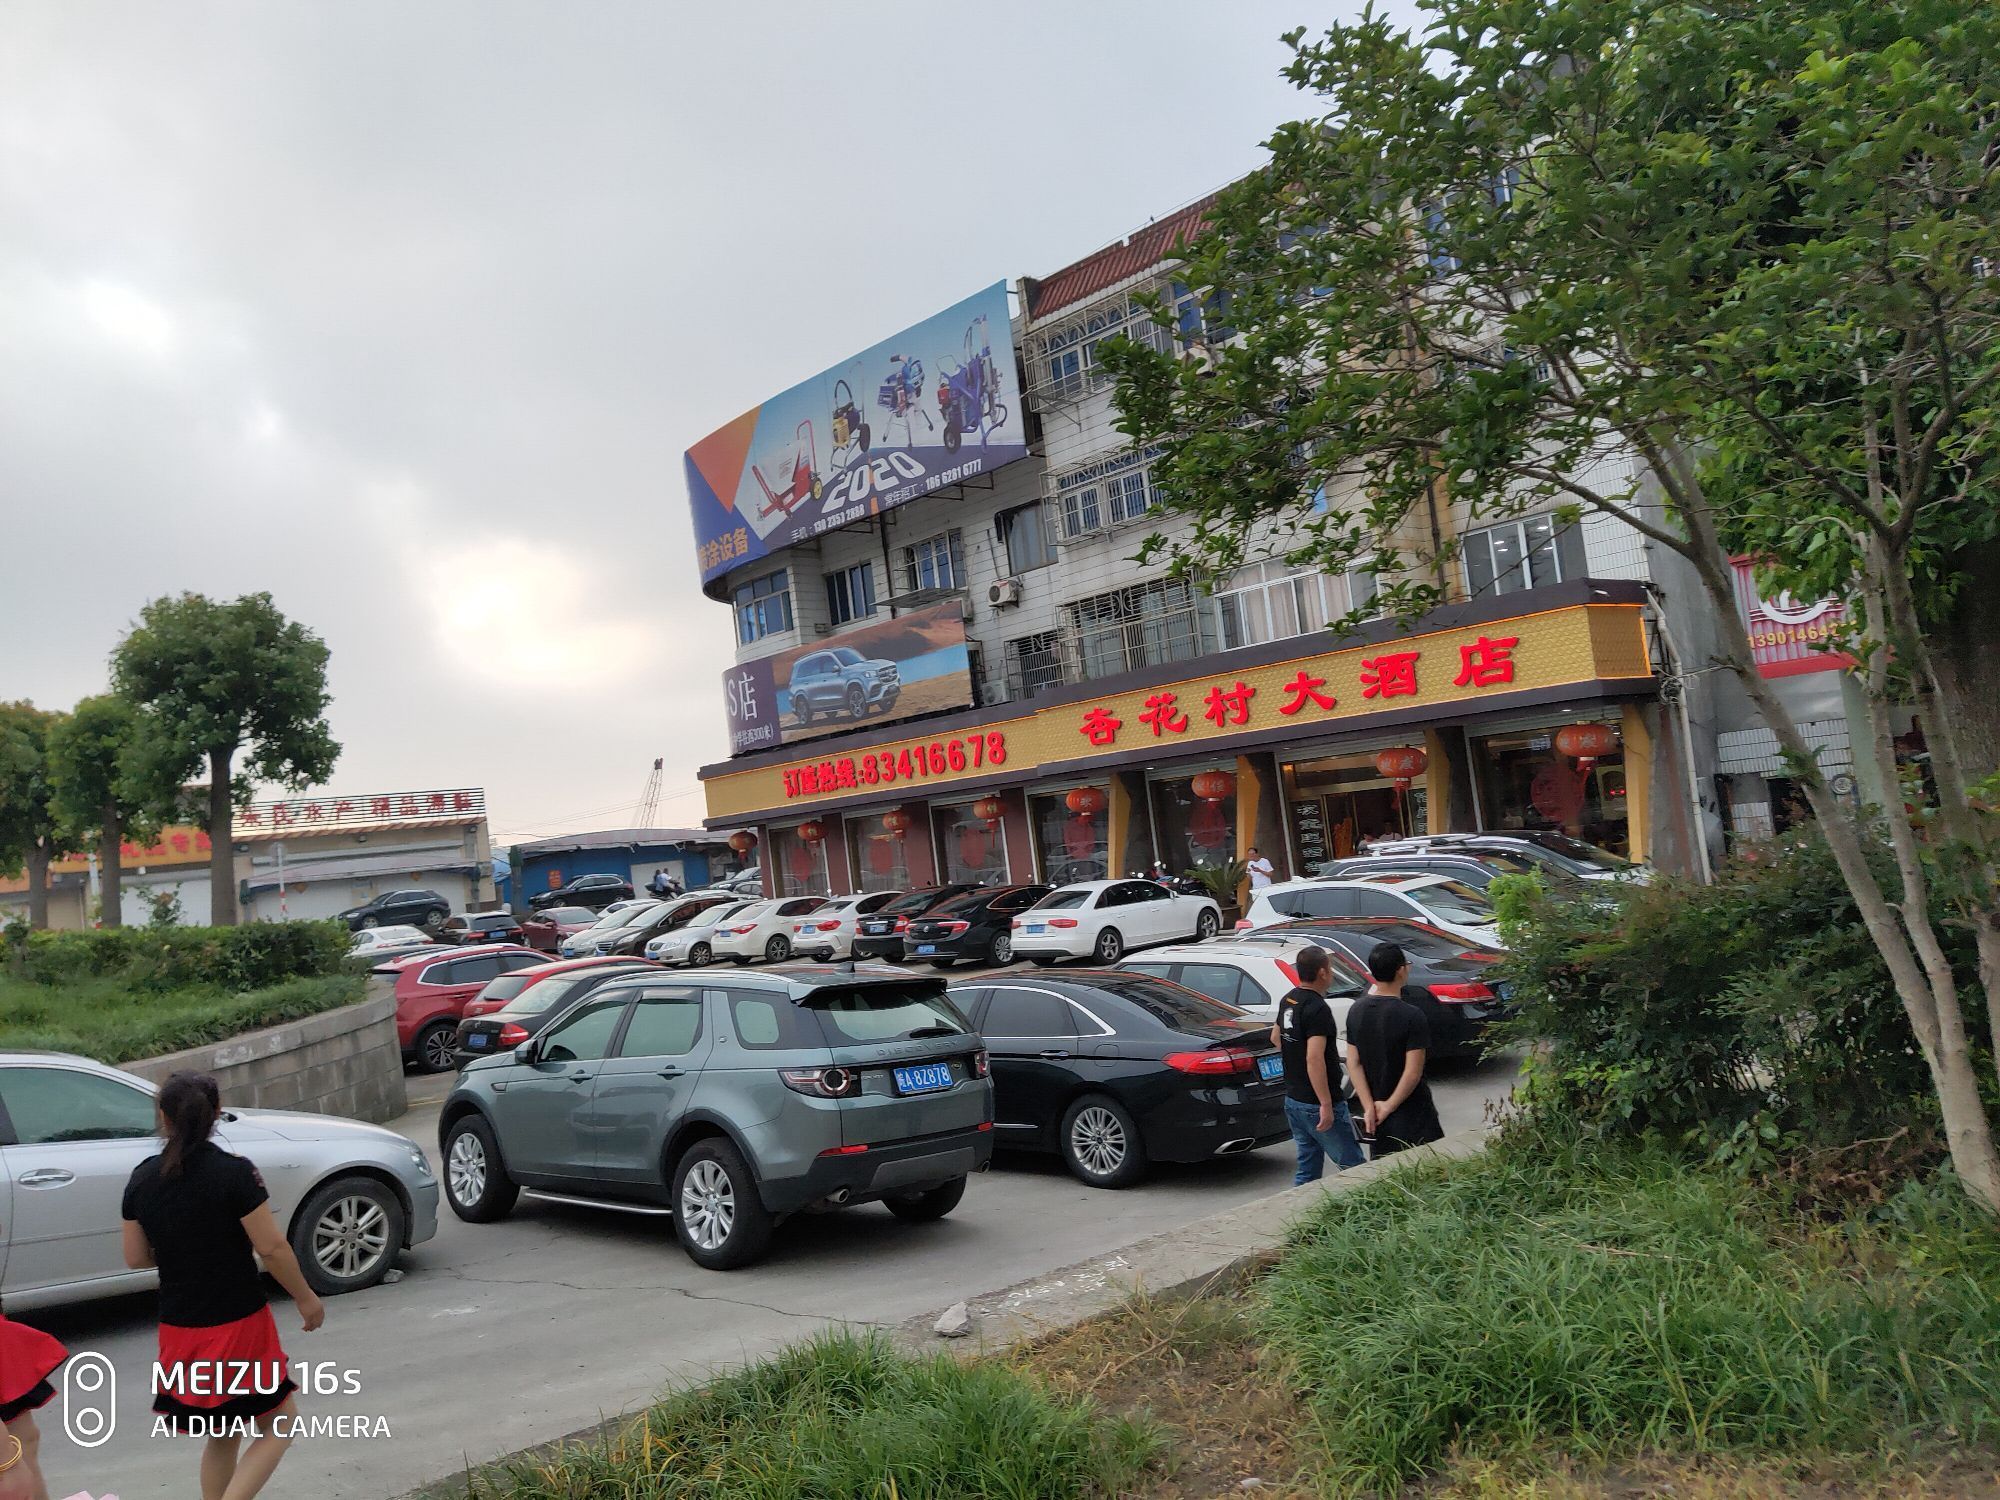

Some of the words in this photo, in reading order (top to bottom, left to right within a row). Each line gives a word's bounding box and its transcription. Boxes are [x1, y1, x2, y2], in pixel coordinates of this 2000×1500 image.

[821, 451, 926, 514] 2020
[925, 474, 941, 490] 186
[942, 466, 962, 484] 6281
[963, 458, 982, 476] 6777
[1747, 619, 1857, 649] 139014642
[1079, 635, 1520, 747] 杏花村大酒店
